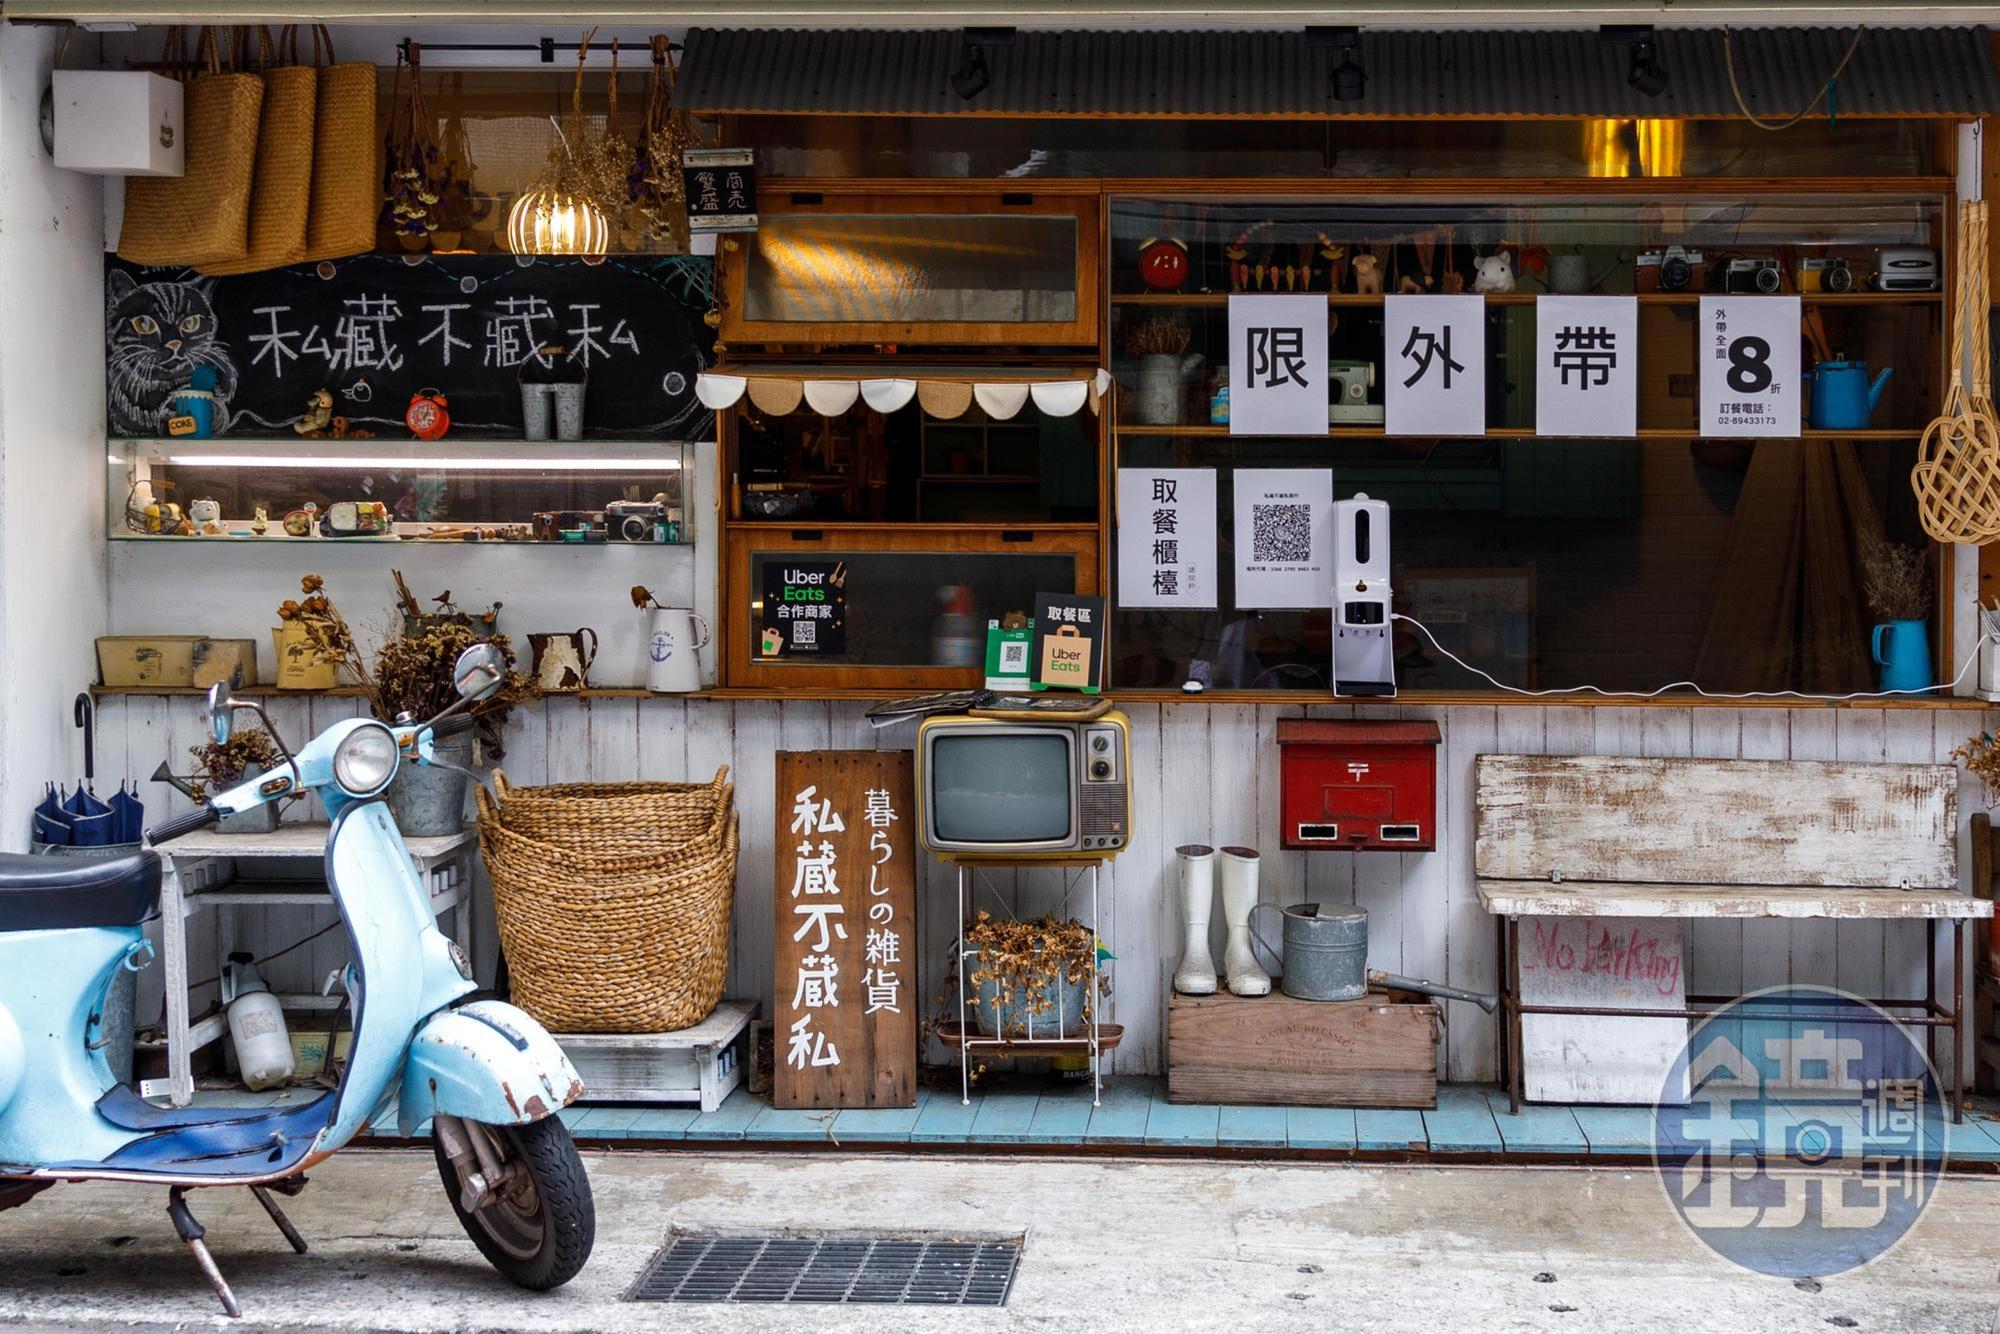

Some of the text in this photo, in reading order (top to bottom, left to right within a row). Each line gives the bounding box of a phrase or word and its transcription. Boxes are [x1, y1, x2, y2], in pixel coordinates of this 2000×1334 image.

[1715, 309, 1727, 359] 外帶全面
[1247, 327, 1309, 389] 限
[1401, 325, 1465, 390] 外
[1554, 326, 1616, 390] 帶
[1718, 417, 1776, 425] 02-89433173
[1152, 478, 1178, 596] 取餐櫃檯
[784, 569, 825, 584] Uber
[784, 586, 825, 601] Eats
[777, 604, 832, 618] 合作商家
[1047, 606, 1091, 623] 取餐區
[1052, 648, 1081, 660] Uber
[1051, 660, 1080, 673] Eats
[860, 788, 901, 1015] 暮らしの雑貨
